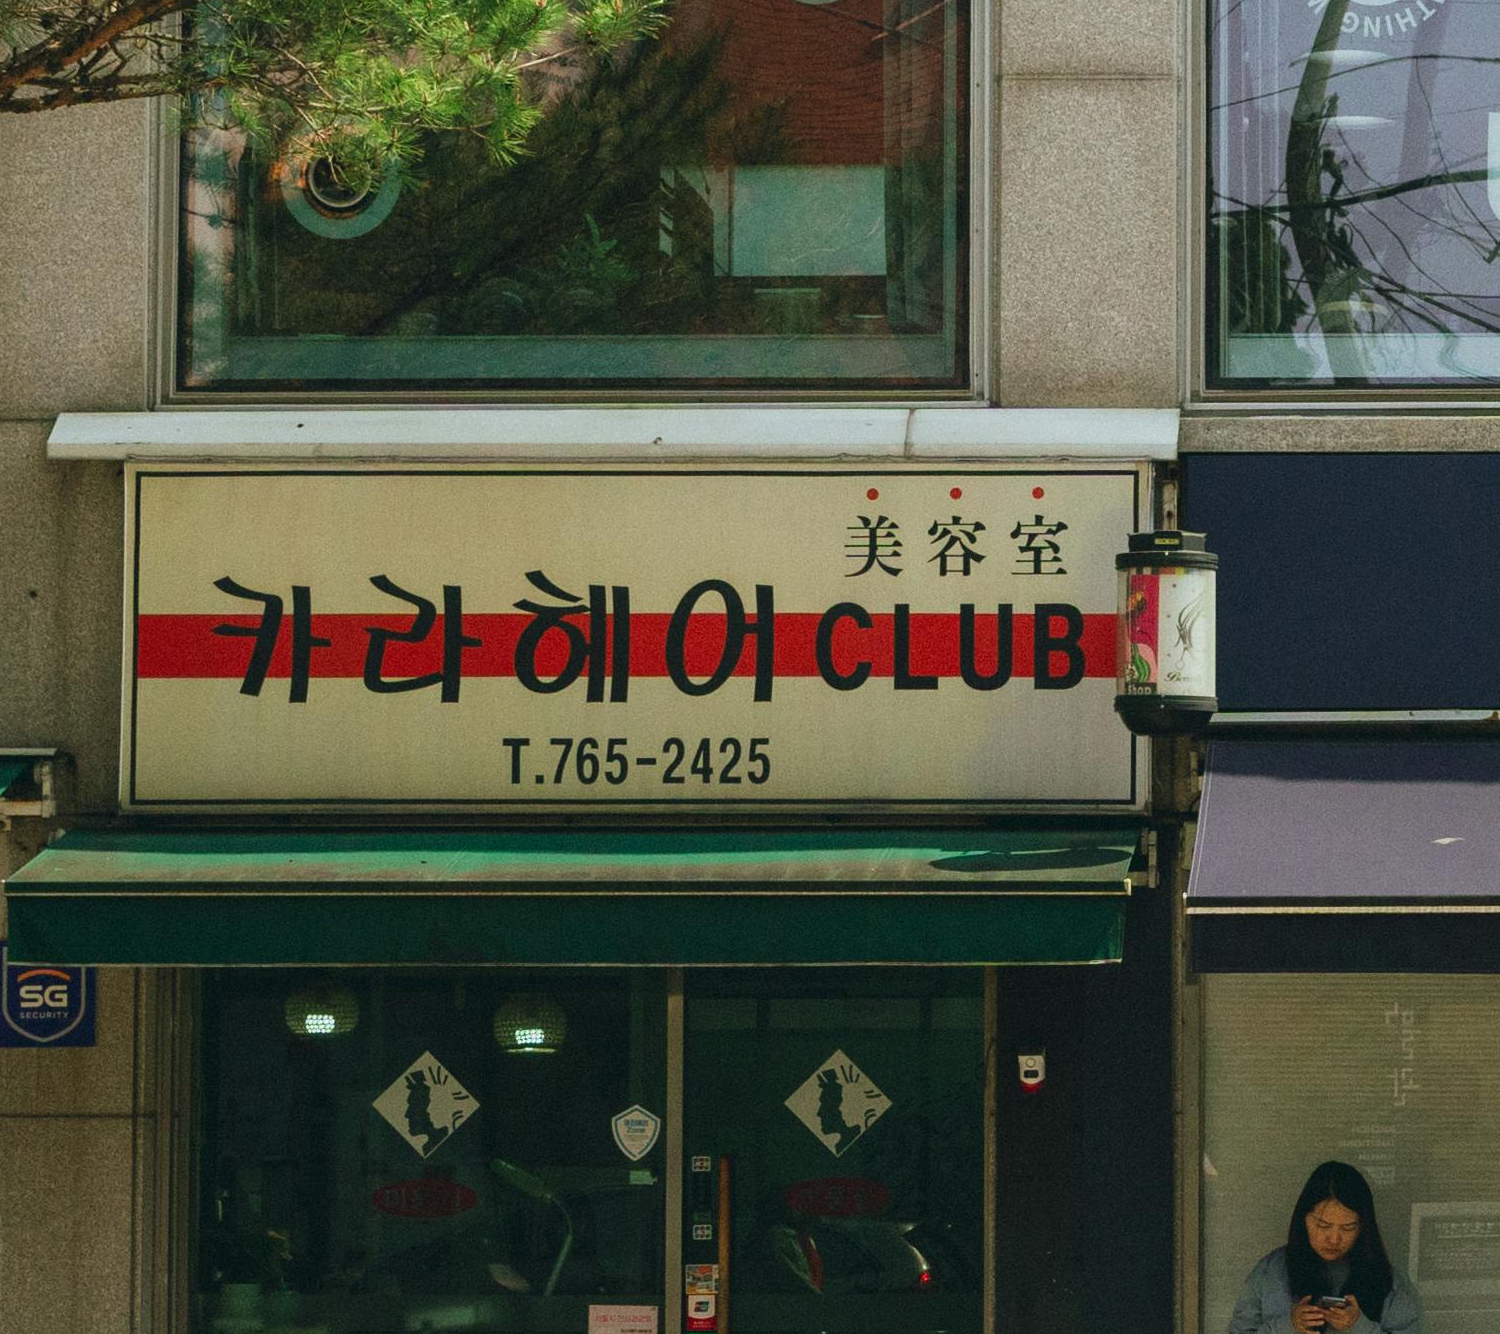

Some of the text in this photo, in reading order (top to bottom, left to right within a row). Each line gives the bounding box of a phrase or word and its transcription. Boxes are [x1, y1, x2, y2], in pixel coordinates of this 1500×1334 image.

[842, 511, 1070, 579] 美容室
[211, 568, 1088, 704] 카라헤어 CLUB
[502, 736, 773, 786] T.765-2425
[19, 984, 68, 1008] SG
[19, 1011, 69, 1020] SECURITY
